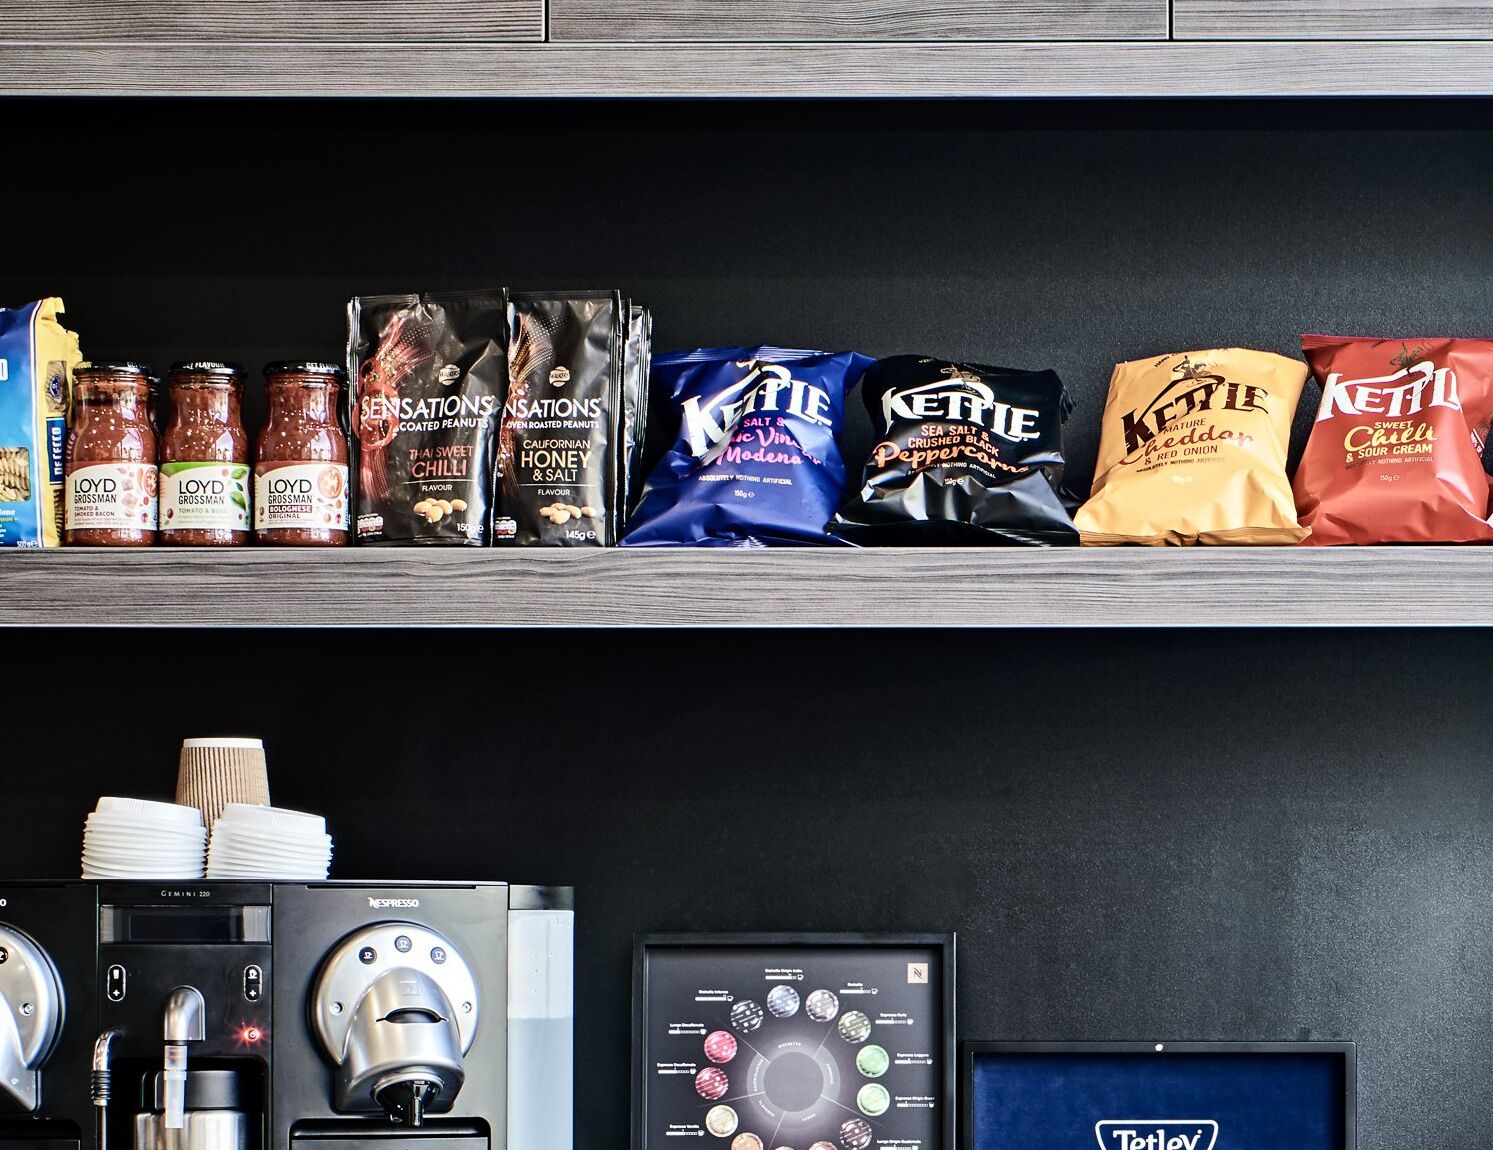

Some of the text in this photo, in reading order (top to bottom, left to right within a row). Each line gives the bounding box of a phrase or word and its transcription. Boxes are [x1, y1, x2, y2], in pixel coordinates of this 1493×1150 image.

[361, 394, 496, 421] SENSATIONS
[503, 397, 601, 419] NSATIONS
[880, 378, 1041, 443] KETTLE
[1120, 374, 1269, 456] KETTLE
[400, 418, 489, 432] COATED PEANUTS
[506, 420, 600, 429] OVEN ROASTED PEANUTS
[743, 417, 772, 427] SALT
[1163, 417, 1207, 435] MATURE
[1374, 420, 1414, 430] SWEET
[921, 425, 990, 443] SEA SALT &
[1343, 422, 1439, 453] Chilli
[523, 439, 591, 450] CALIFORNIAN
[907, 436, 1000, 457] CRUSHED BLACK
[1118, 424, 1254, 466] Cheddar
[409, 445, 474, 460] THAI SWEET
[521, 450, 592, 469] HONEY
[715, 446, 804, 466] Modena
[873, 441, 1029, 473] Peppercorns
[1144, 445, 1218, 466] & RED ONION
[1345, 443, 1434, 463] & SOUR CREAM
[411, 459, 468, 478] CHILLI
[1377, 457, 1403, 465] NOTHING
[532, 468, 579, 482] & SALT
[735, 475, 761, 483] NOTHING
[762, 476, 793, 485] ARTIFICIAL
[74, 478, 117, 494] LOYD
[178, 479, 225, 495] LOYD
[268, 479, 313, 494] LOYD
[421, 484, 453, 492] FLAVOUR
[537, 488, 571, 496] FLAVOUR
[74, 493, 118, 504] GROSSMAN
[178, 494, 225, 505] GROSSMAN
[268, 494, 313, 505] GROSSMAN
[269, 505, 312, 513] BOLOGNESE
[565, 530, 586, 540] 145g
[367, 897, 420, 909] NESPRESSO
